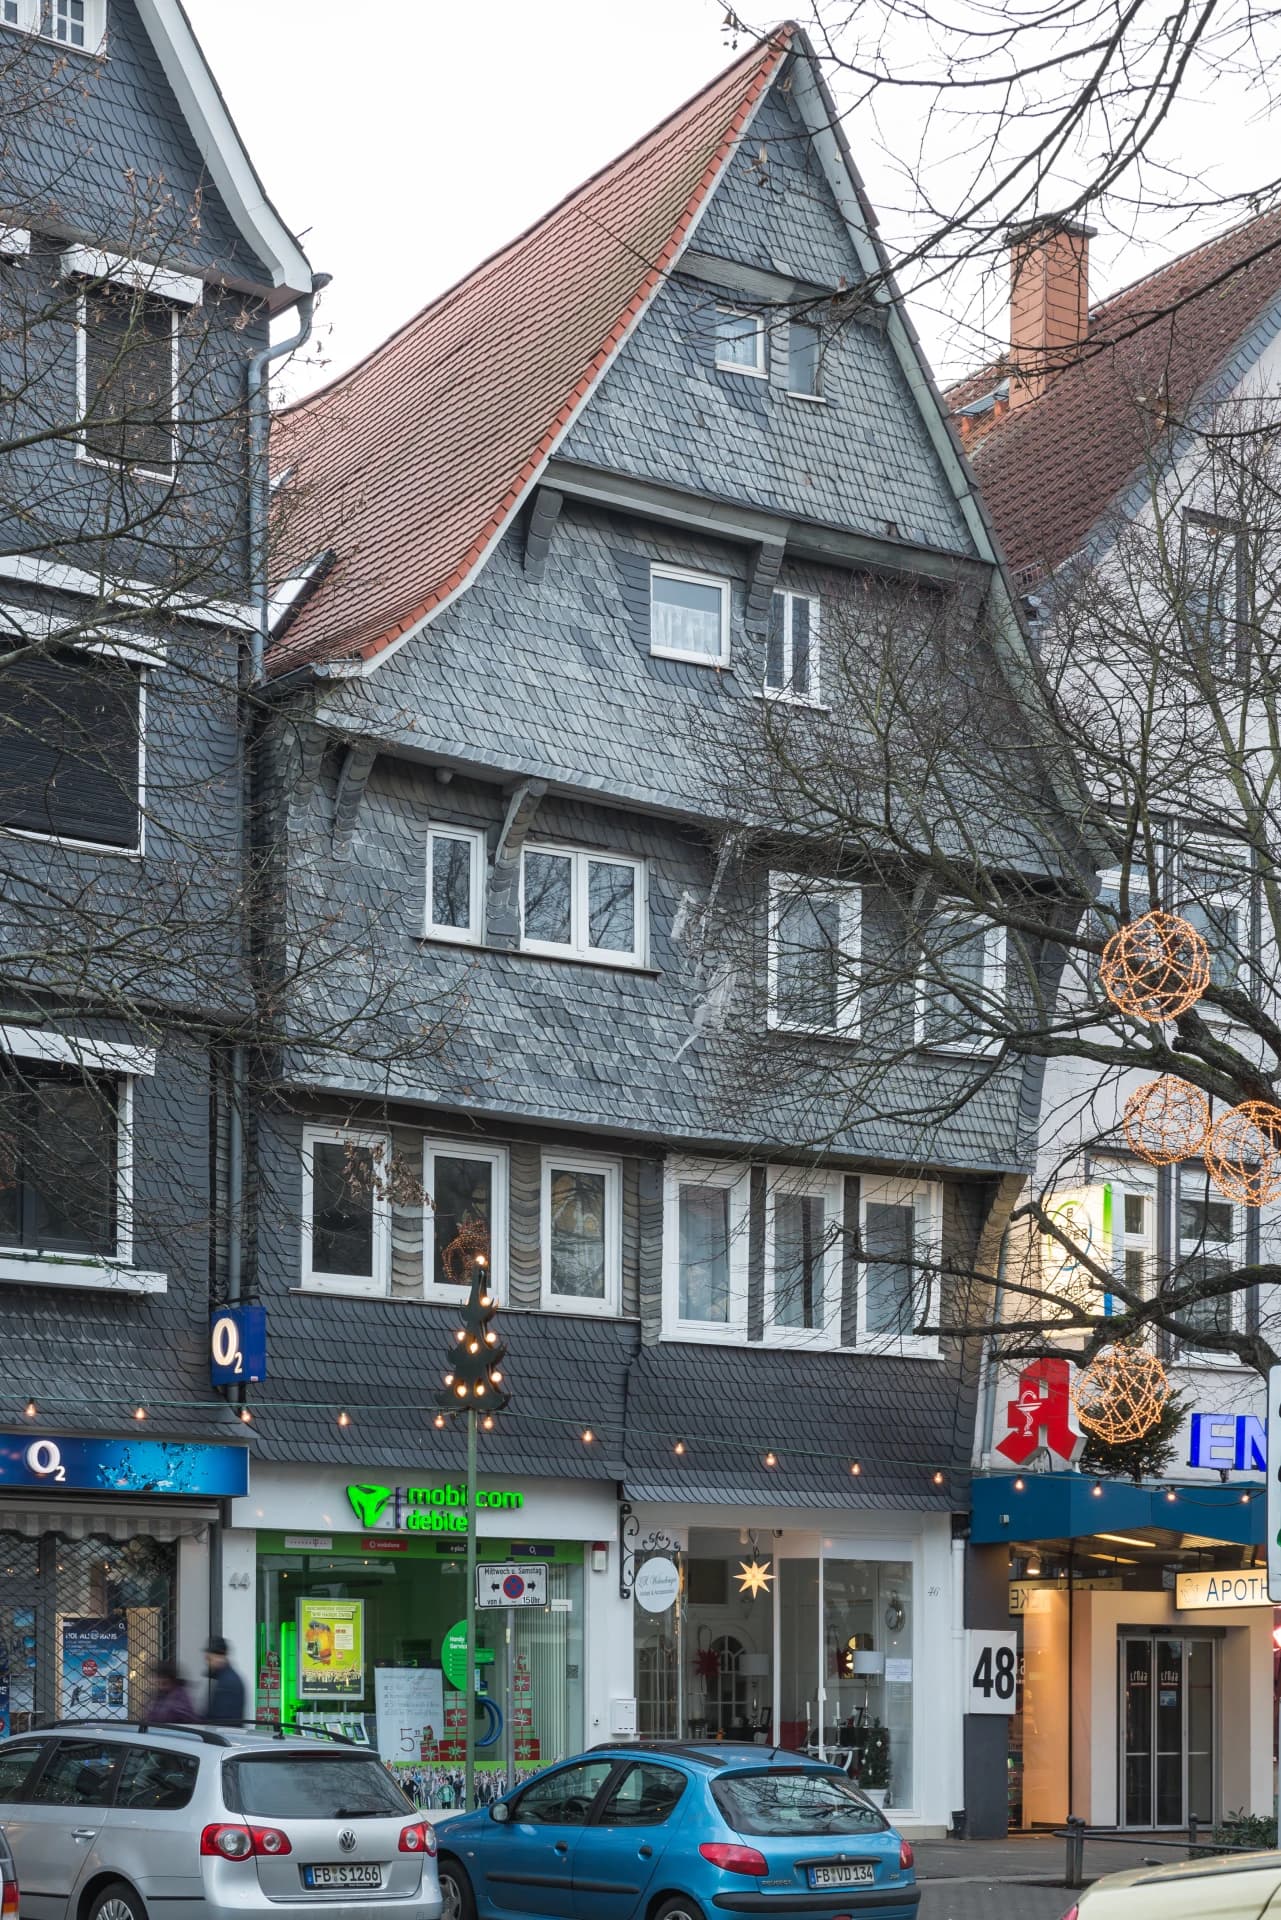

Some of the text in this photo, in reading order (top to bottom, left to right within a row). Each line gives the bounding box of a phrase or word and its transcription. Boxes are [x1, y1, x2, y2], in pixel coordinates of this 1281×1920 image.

[407, 1483, 524, 1509] mobicom
[407, 1509, 469, 1532] debite
[973, 1646, 1015, 1700] 48
[314, 1867, 331, 1882] FB
[815, 1866, 873, 1883] FB VD 134
